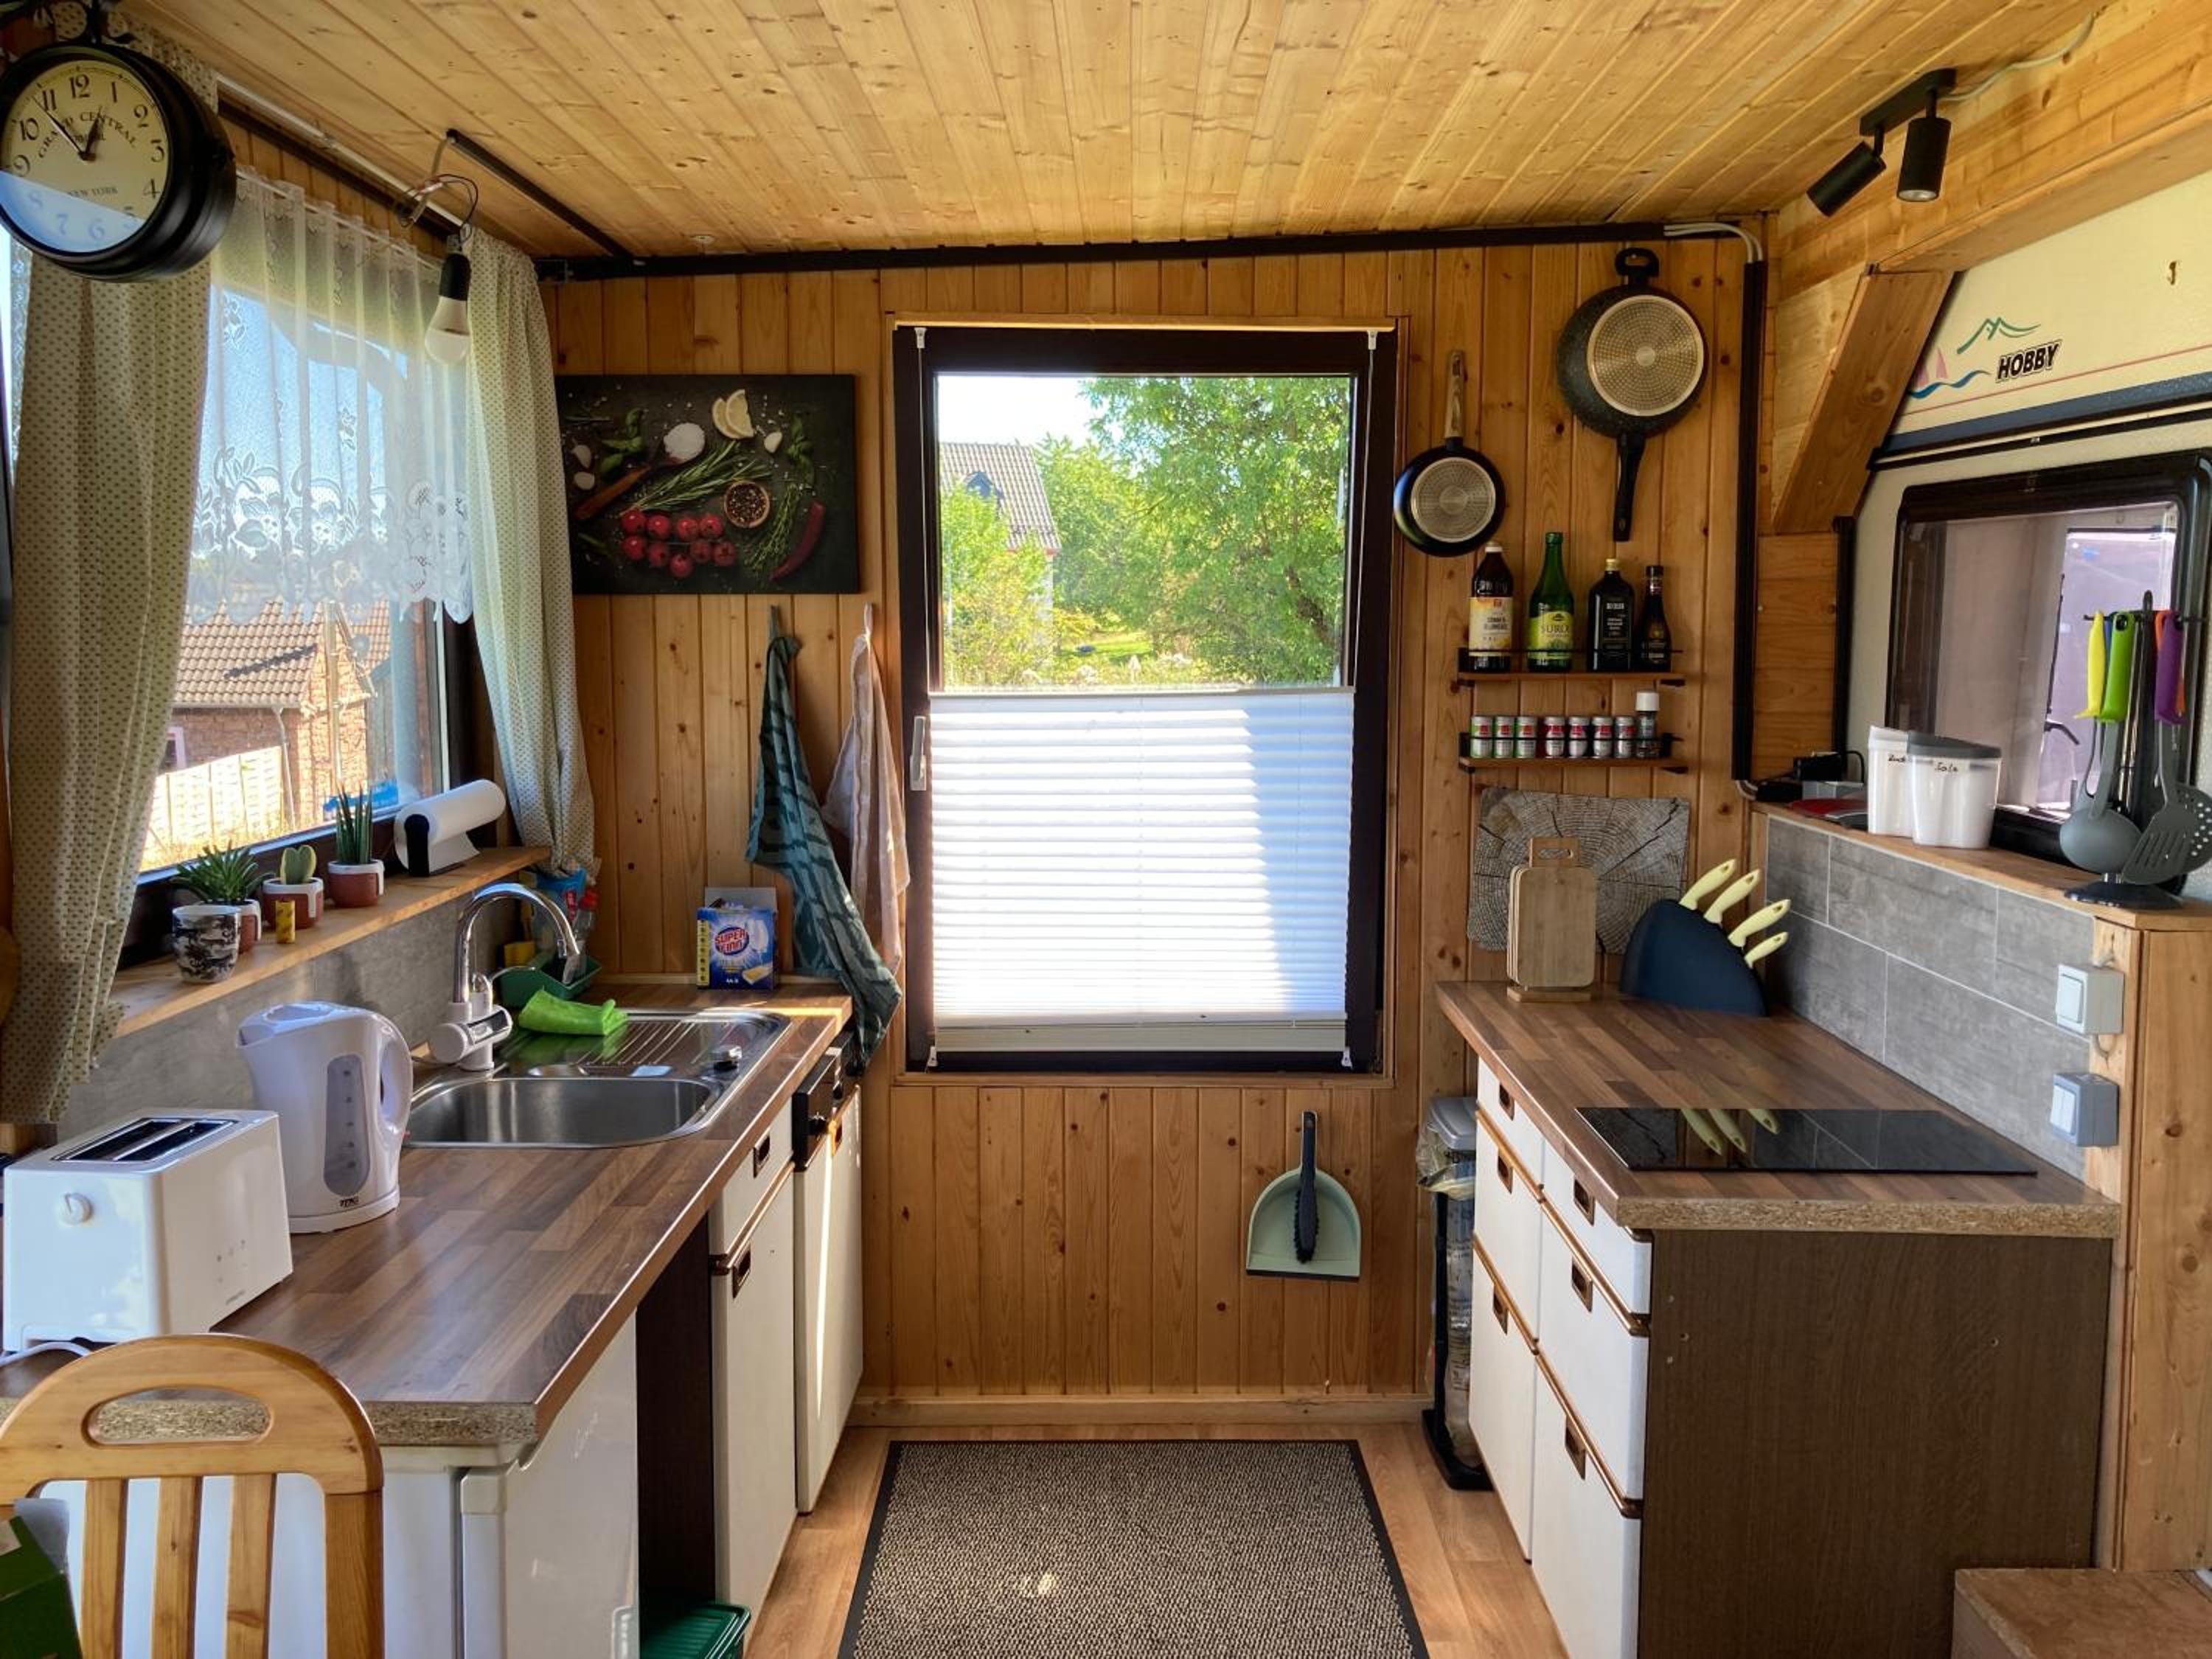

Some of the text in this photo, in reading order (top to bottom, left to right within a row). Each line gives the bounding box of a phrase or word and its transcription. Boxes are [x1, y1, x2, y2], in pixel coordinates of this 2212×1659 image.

[69, 74, 91, 99] 12
[111, 81, 119, 104] 1
[42, 88, 57, 111] 11
[133, 105, 149, 128] 2
[19, 117, 39, 142] 10
[150, 138, 164, 163] 3
[13, 154, 30, 178] 9
[143, 178, 161, 199] 4
[56, 213, 69, 236] 7
[88, 218, 105, 241] 6
[1996, 340, 2062, 382] HOBBY
[715, 928, 747, 944] SUPER
